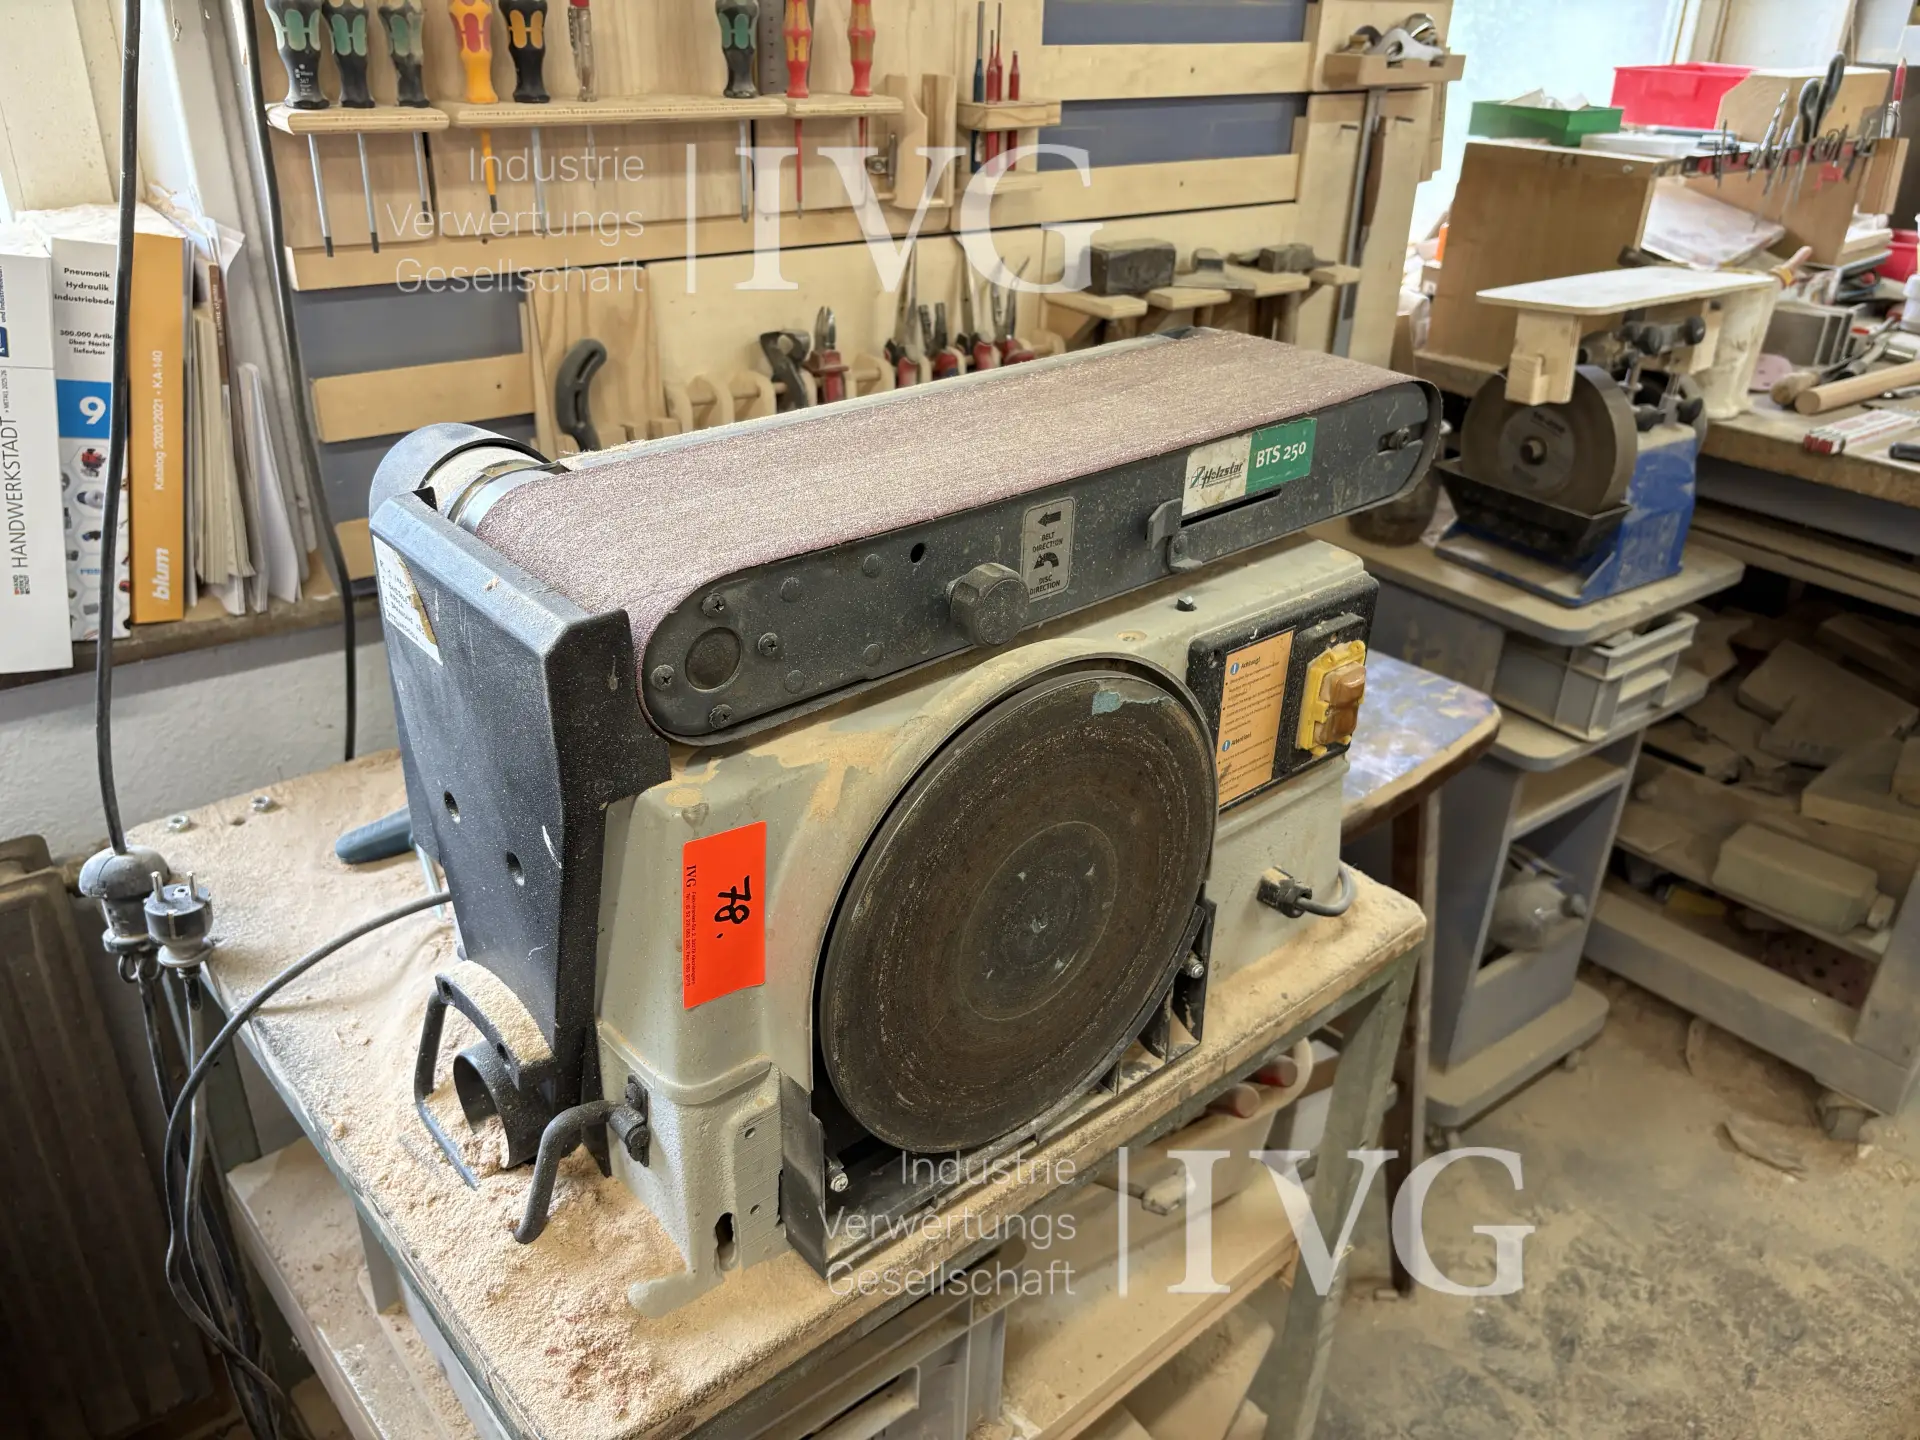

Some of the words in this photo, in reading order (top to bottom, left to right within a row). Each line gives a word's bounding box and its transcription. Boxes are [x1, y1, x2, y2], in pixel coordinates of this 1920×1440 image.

[63, 267, 111, 278] Pneumatik
[65, 281, 109, 291] Hydraulik
[54, 293, 115, 305] Industriebeda
[93, 332, 113, 340] Artik
[79, 395, 107, 425] 9
[1255, 444, 1282, 469] BTS
[1282, 441, 1307, 462] 250
[154, 450, 167, 491] Katalog
[1201, 462, 1244, 489] Holzstar
[0, 415, 28, 569] HANDWERKSTADT
[1041, 531, 1056, 541] BELT
[1032, 537, 1063, 553] DIRECTION
[152, 548, 170, 601] blum
[1038, 574, 1053, 585] DISC
[1029, 579, 1061, 596] DIRECTION
[686, 864, 697, 889] IVG
